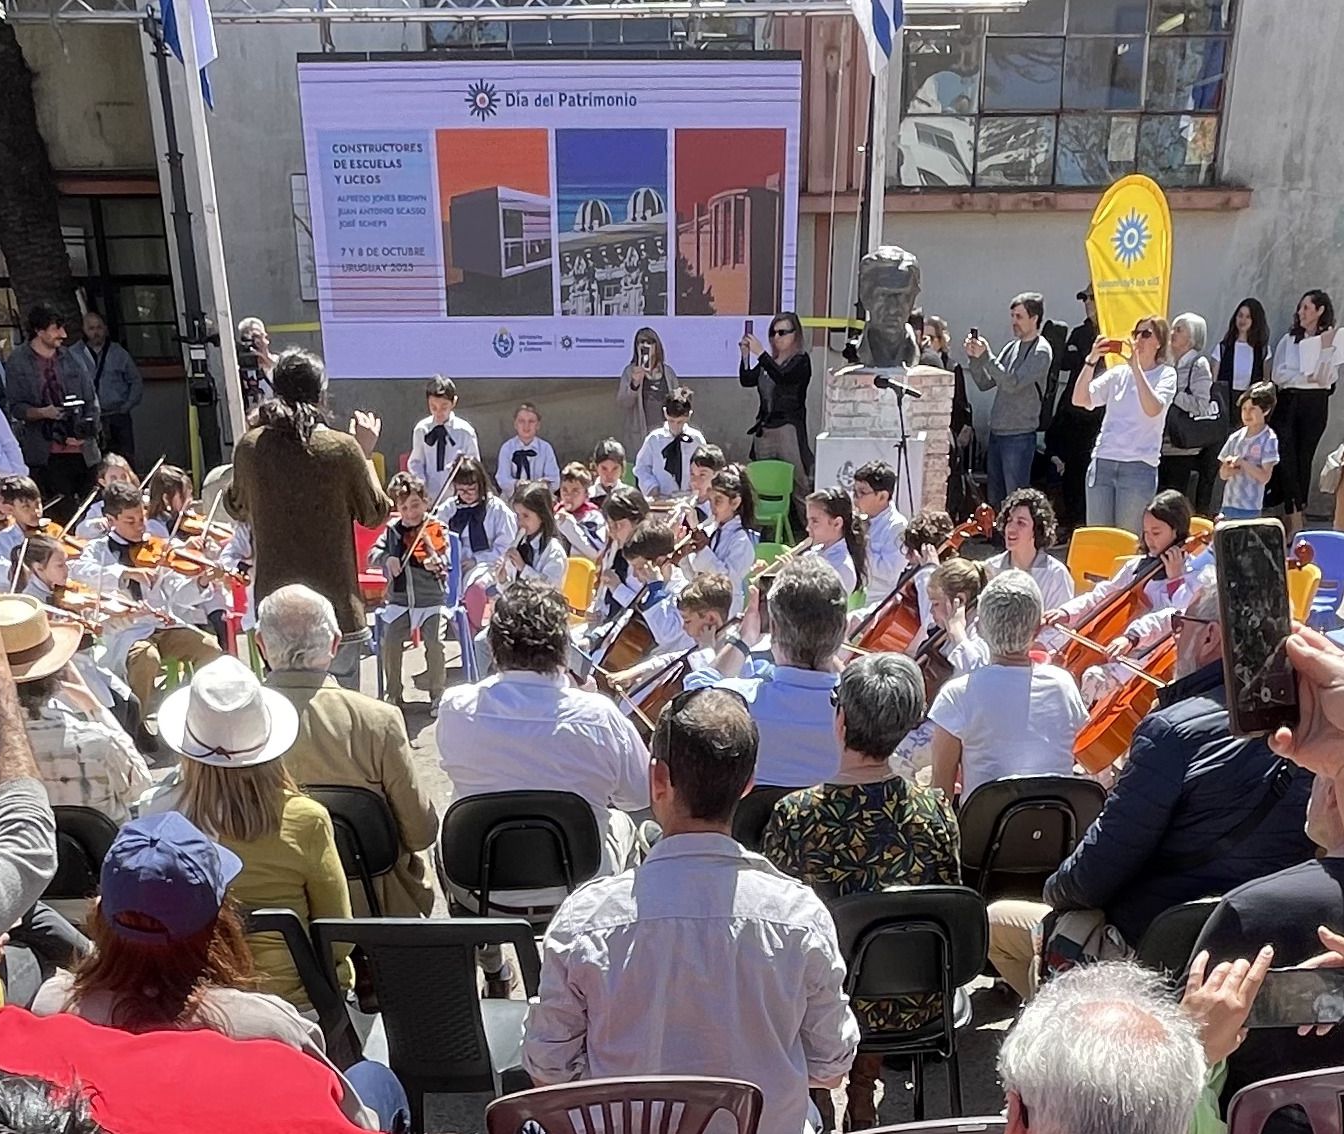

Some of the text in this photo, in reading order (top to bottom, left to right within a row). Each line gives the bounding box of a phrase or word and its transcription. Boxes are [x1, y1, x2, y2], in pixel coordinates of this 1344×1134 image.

[506, 91, 637, 107] Día del Patrimonio
[332, 143, 423, 154] CONSTRUCTORES
[333, 159, 402, 169] DE ESCUELAS
[335, 175, 381, 184] Y LICEOS
[349, 248, 355, 257] Y
[366, 247, 378, 257] DE
[382, 247, 425, 257] OCTUBRE
[341, 264, 388, 273] URUGUAY
